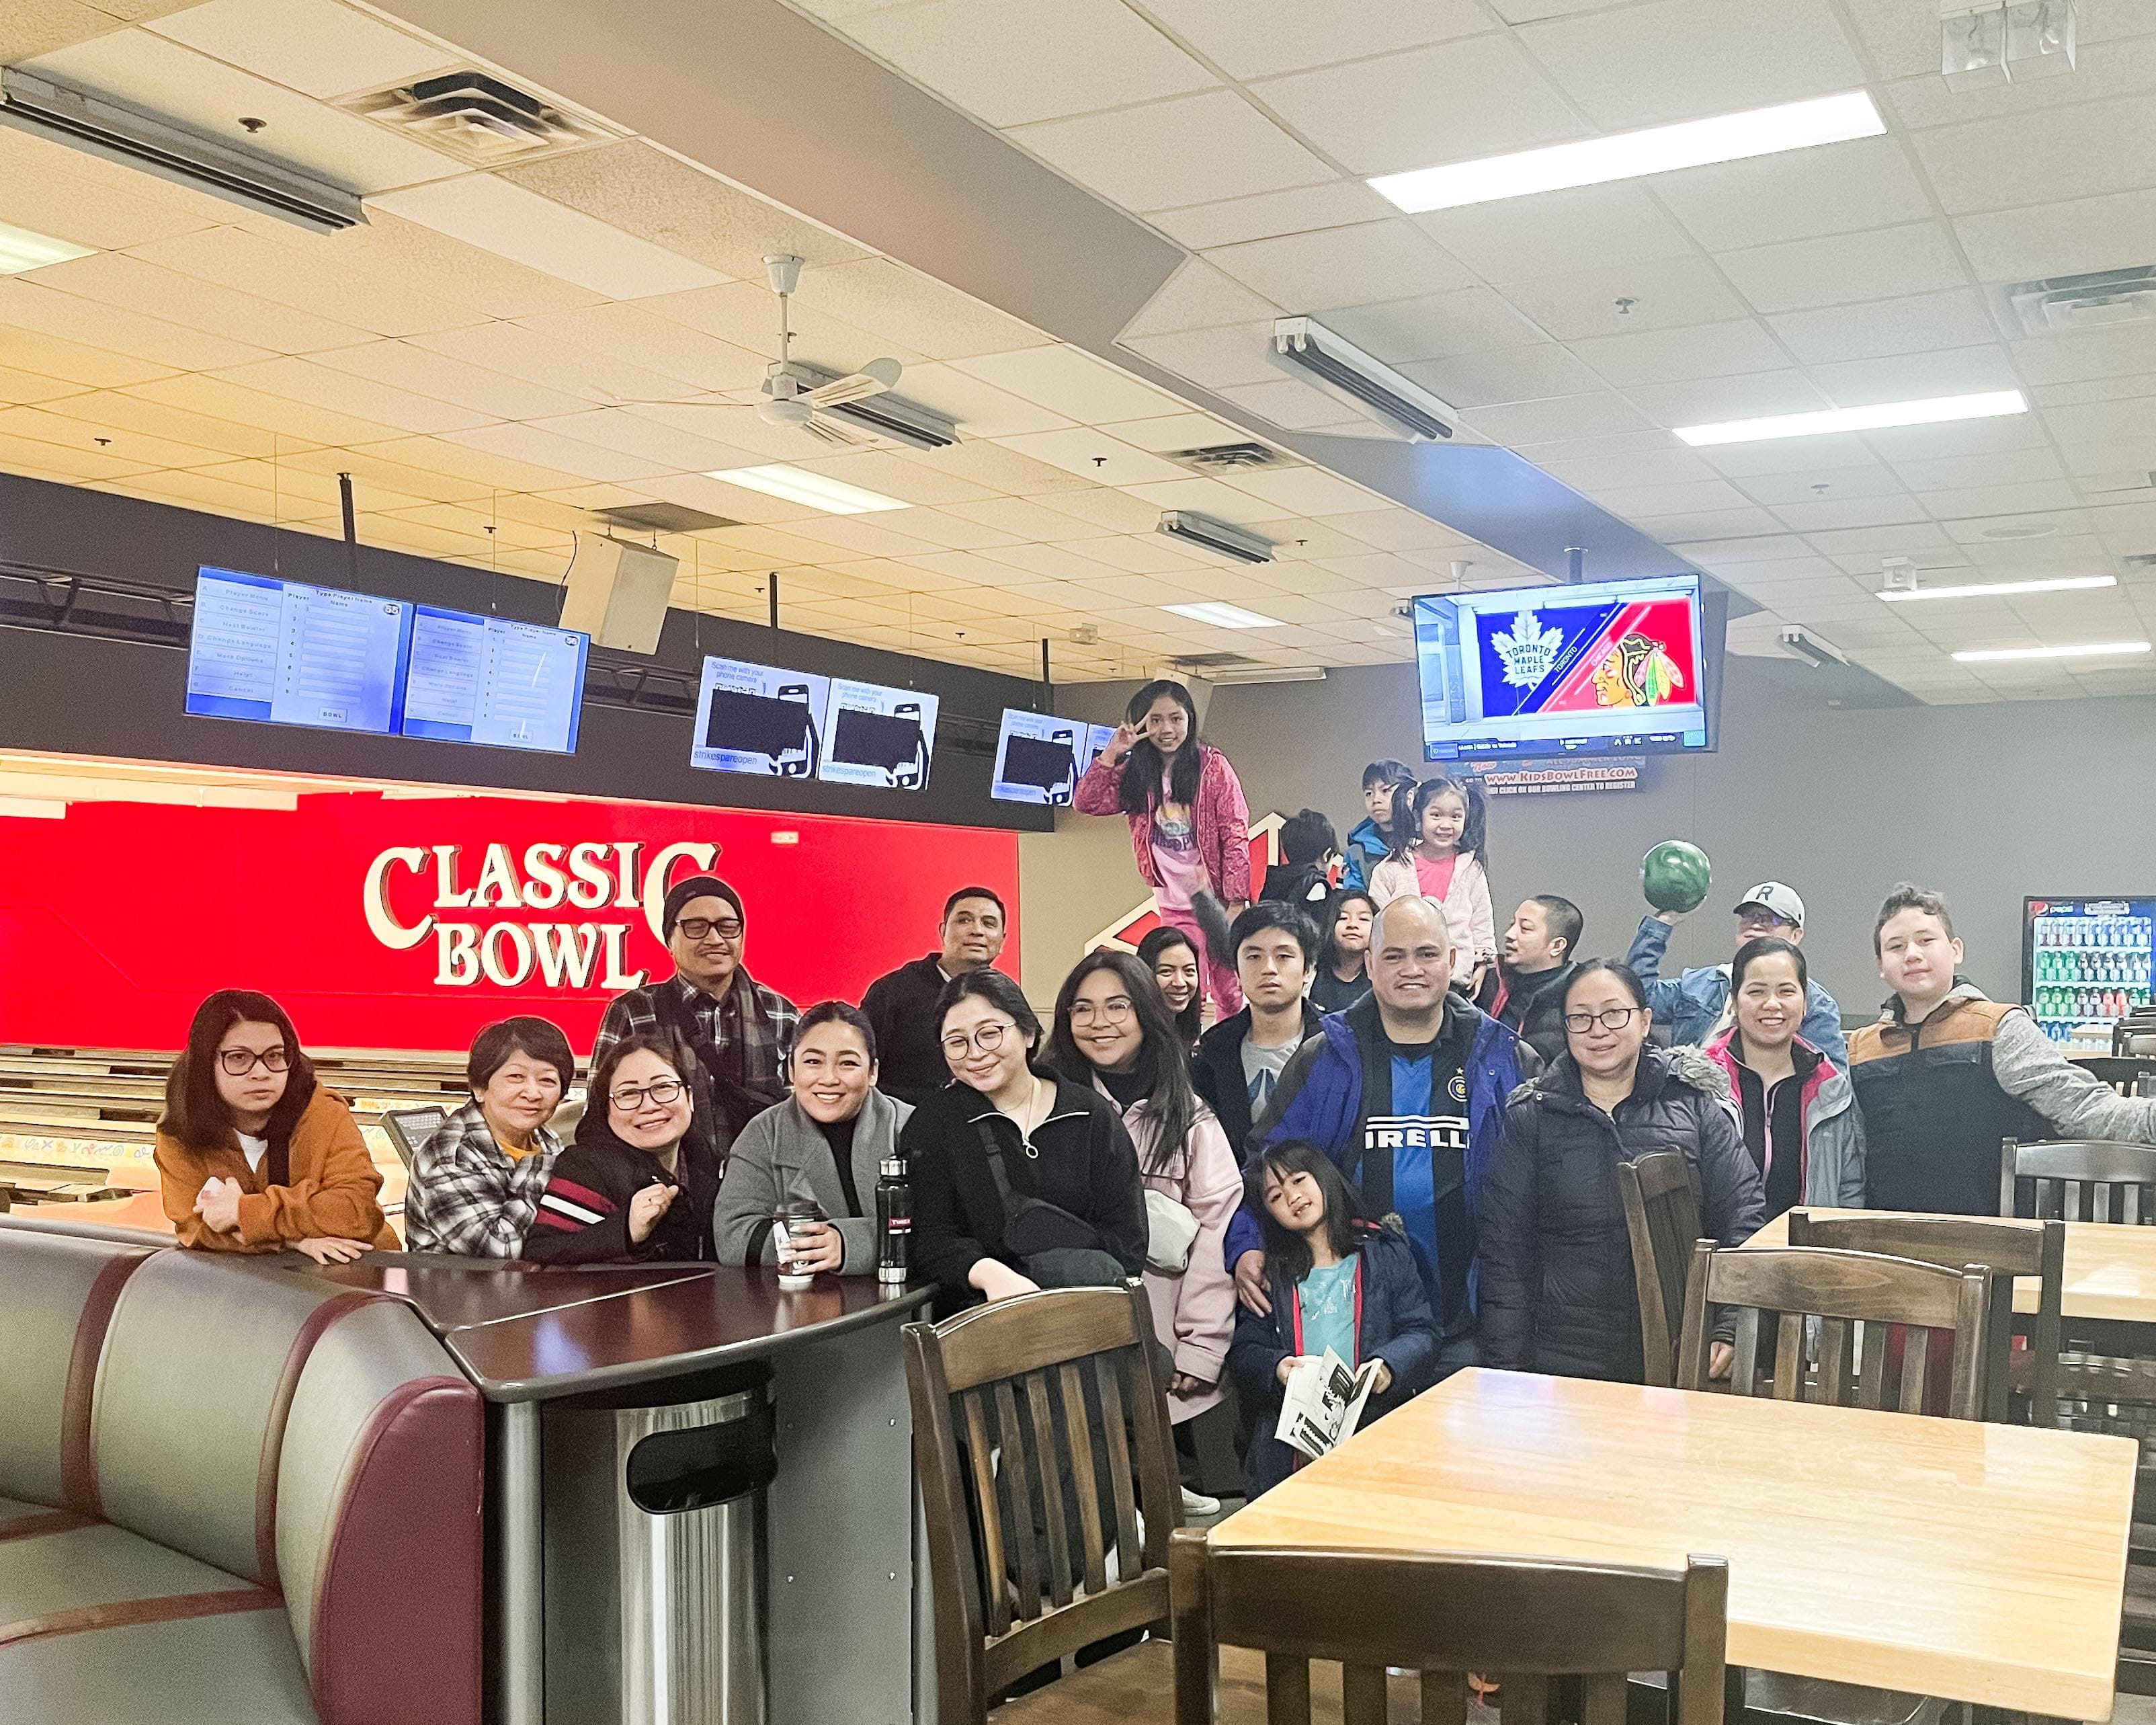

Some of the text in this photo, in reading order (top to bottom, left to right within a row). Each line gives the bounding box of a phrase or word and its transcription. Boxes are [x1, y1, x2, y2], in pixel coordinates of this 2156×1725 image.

[288, 592, 310, 601] Player
[1506, 644, 1552, 658] TORONTO
[1591, 641, 1613, 667] CHICAGO
[1514, 655, 1544, 665] MAPLE
[1554, 646, 1578, 673] TORONTO
[712, 661, 727, 670] Scan
[751, 670, 764, 678] your
[1514, 664, 1545, 675] LEAFS
[716, 672, 757, 683] phone camera
[694, 750, 757, 765] strikespareopen
[364, 842, 722, 950] CLASSIC
[1755, 885, 1774, 901] R
[433, 922, 652, 990] BOWL
